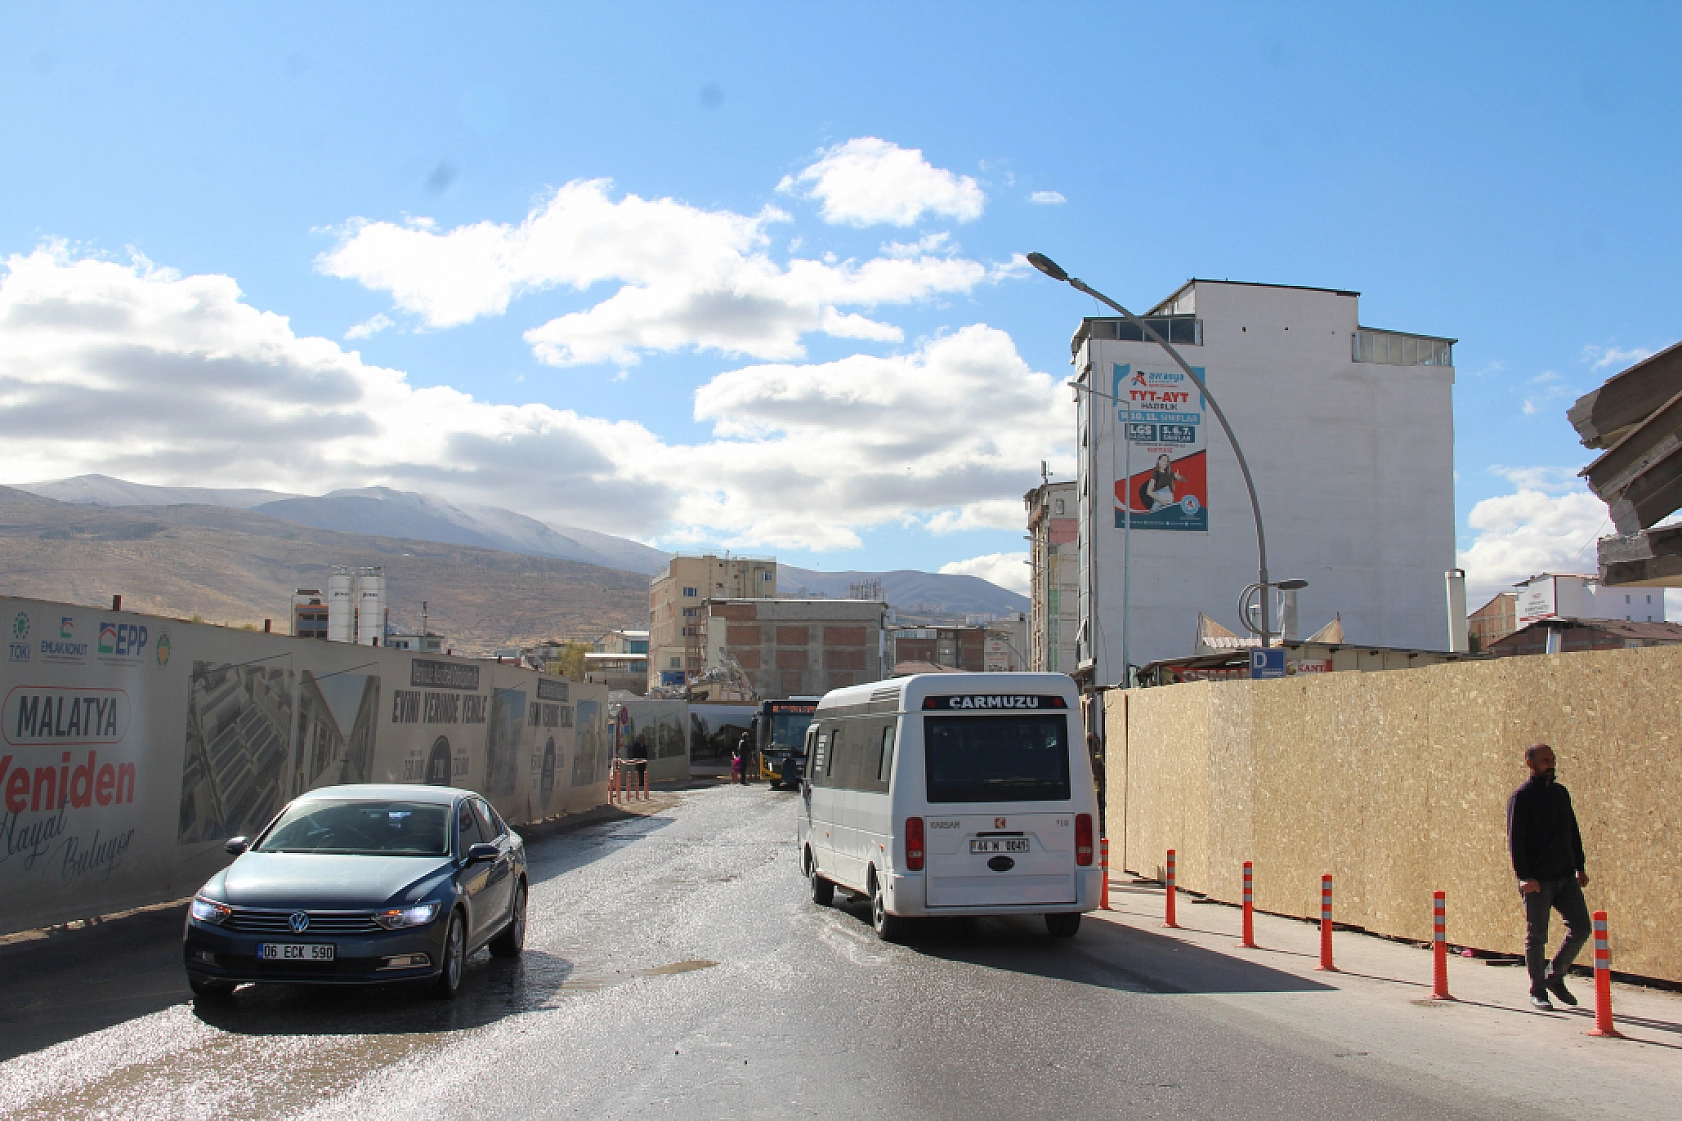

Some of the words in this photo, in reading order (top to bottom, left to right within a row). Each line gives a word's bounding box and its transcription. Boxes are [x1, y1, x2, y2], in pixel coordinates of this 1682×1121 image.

[1129, 390, 1189, 403] TYT-AYT
[1130, 425, 1152, 435] LGS
[116, 623, 148, 656] EPP
[1253, 651, 1267, 668] D
[16, 695, 118, 738] MALATYA
[264, 945, 277, 958] 06
[284, 945, 305, 958] ECK
[312, 945, 333, 959] 590
